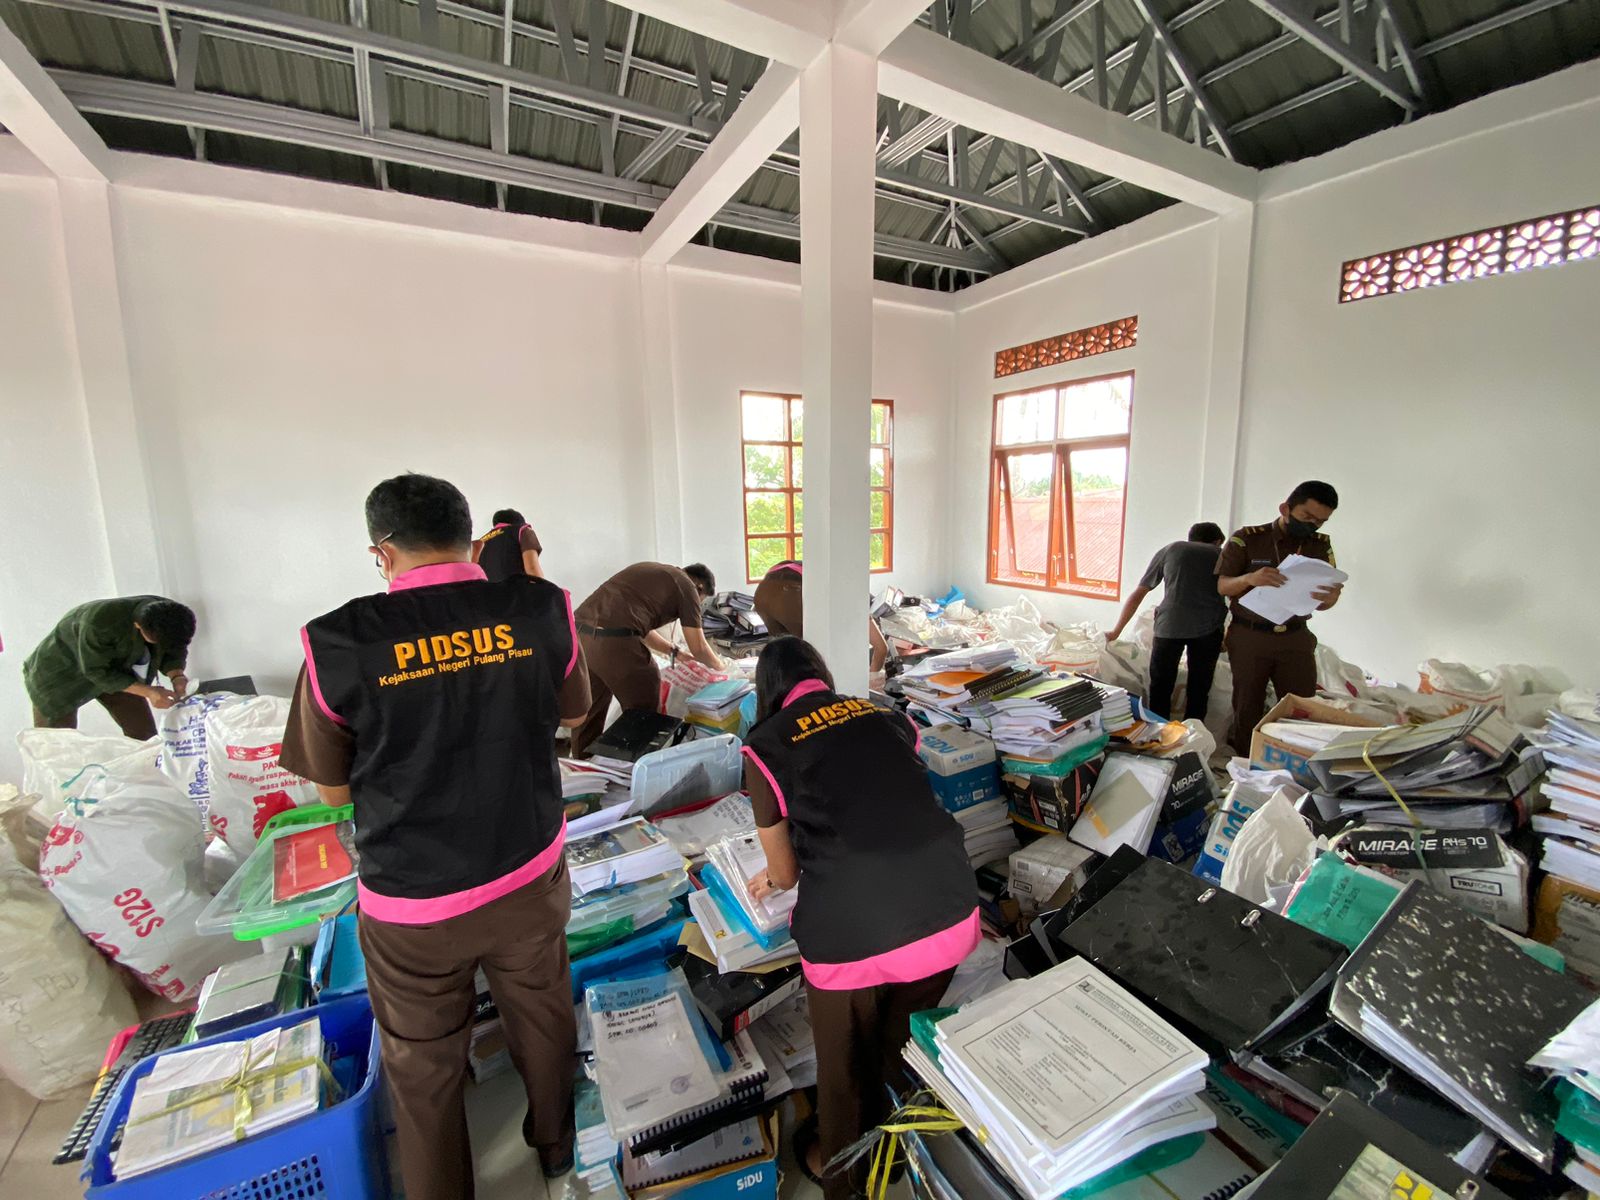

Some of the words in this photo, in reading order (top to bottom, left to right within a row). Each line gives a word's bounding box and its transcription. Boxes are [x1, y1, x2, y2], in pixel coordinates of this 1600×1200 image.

[393, 624, 515, 670] PIDSUS
[379, 667, 435, 686] Kejaksaan
[438, 659, 471, 673] Negeri
[474, 653, 504, 667] Pulang
[508, 647, 533, 659] Pisau
[796, 698, 875, 731] PIDSUS
[1171, 769, 1204, 793] MIRAGE
[1358, 839, 1438, 850] MIRAGE
[1467, 836, 1487, 845] 70
[113, 887, 165, 938] S12G
[736, 1171, 763, 1191] SiDU
